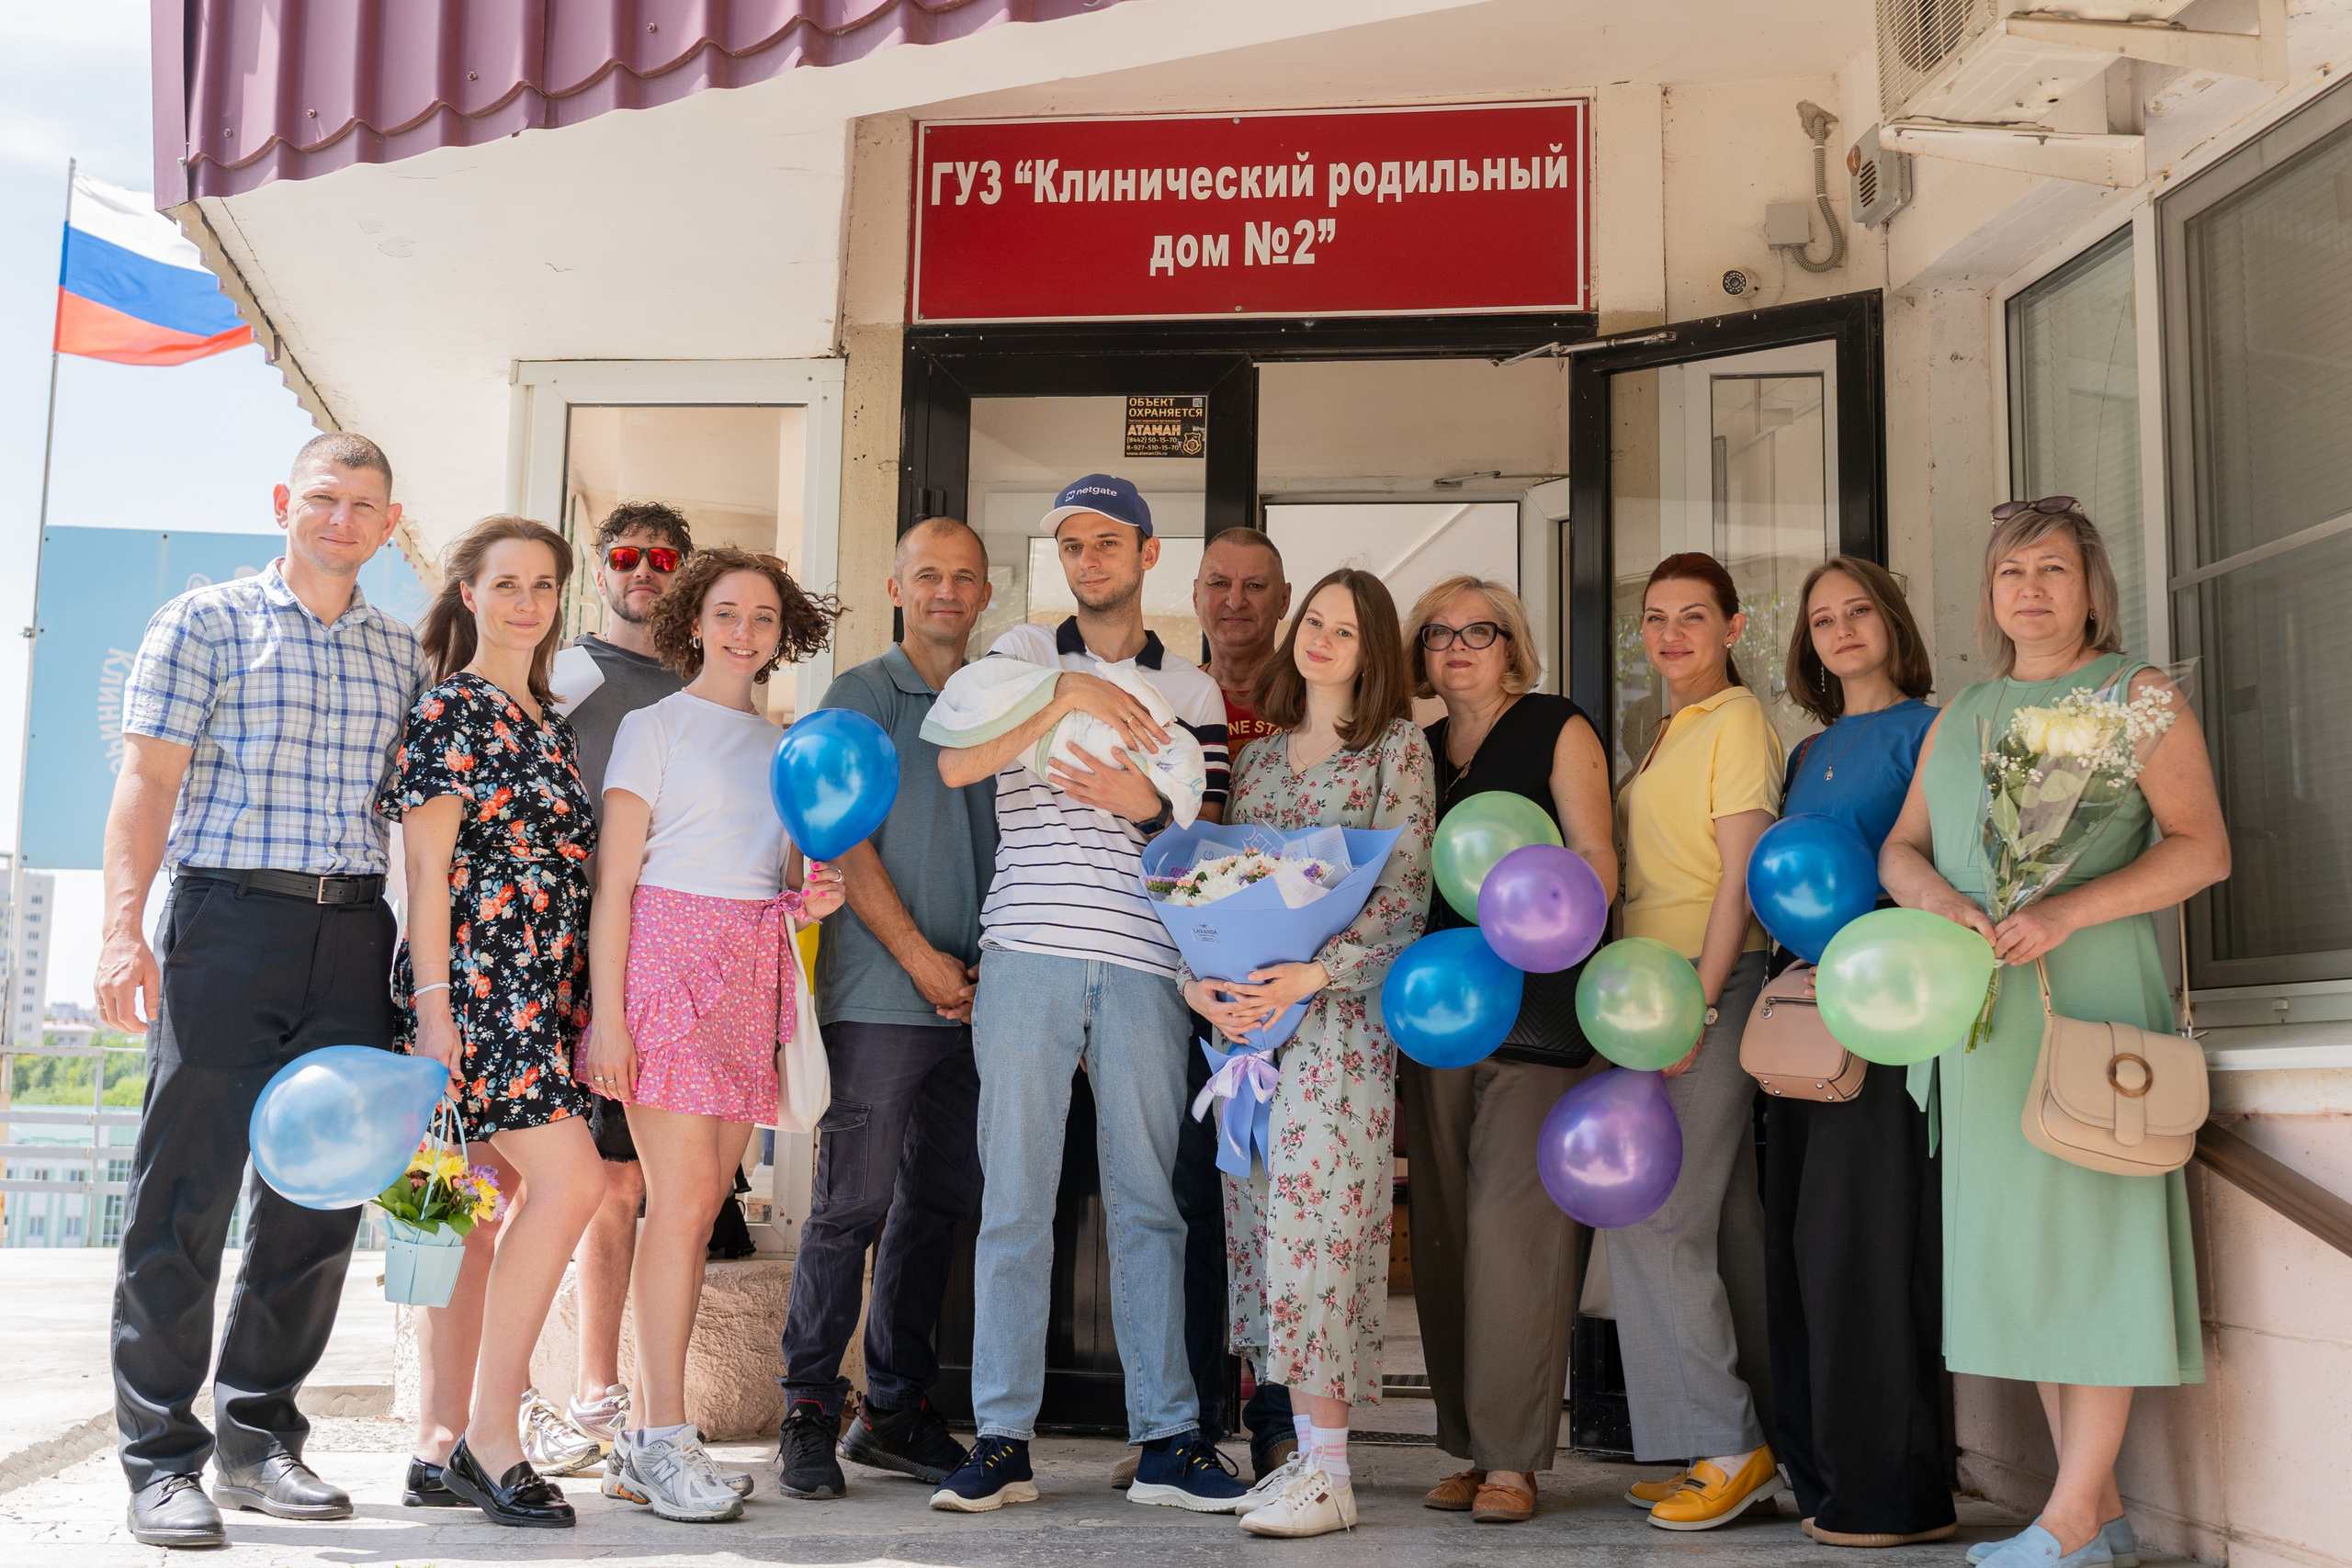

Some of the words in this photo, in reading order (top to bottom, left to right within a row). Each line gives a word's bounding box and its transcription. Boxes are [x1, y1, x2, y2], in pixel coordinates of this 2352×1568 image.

[931, 159, 1002, 206] ГУЗ
[1014, 151, 1315, 204] “Клинический
[1329, 142, 1569, 208] родильный
[1149, 232, 1230, 276] дом
[1128, 397, 1175, 407] ОБЪЕКТ
[1128, 408, 1203, 417] ОХРАНЯЕТСЯ
[1126, 424, 1182, 436] АТАМАН
[1076, 485, 1118, 497] netgate
[1254, 720, 1288, 736] STA
